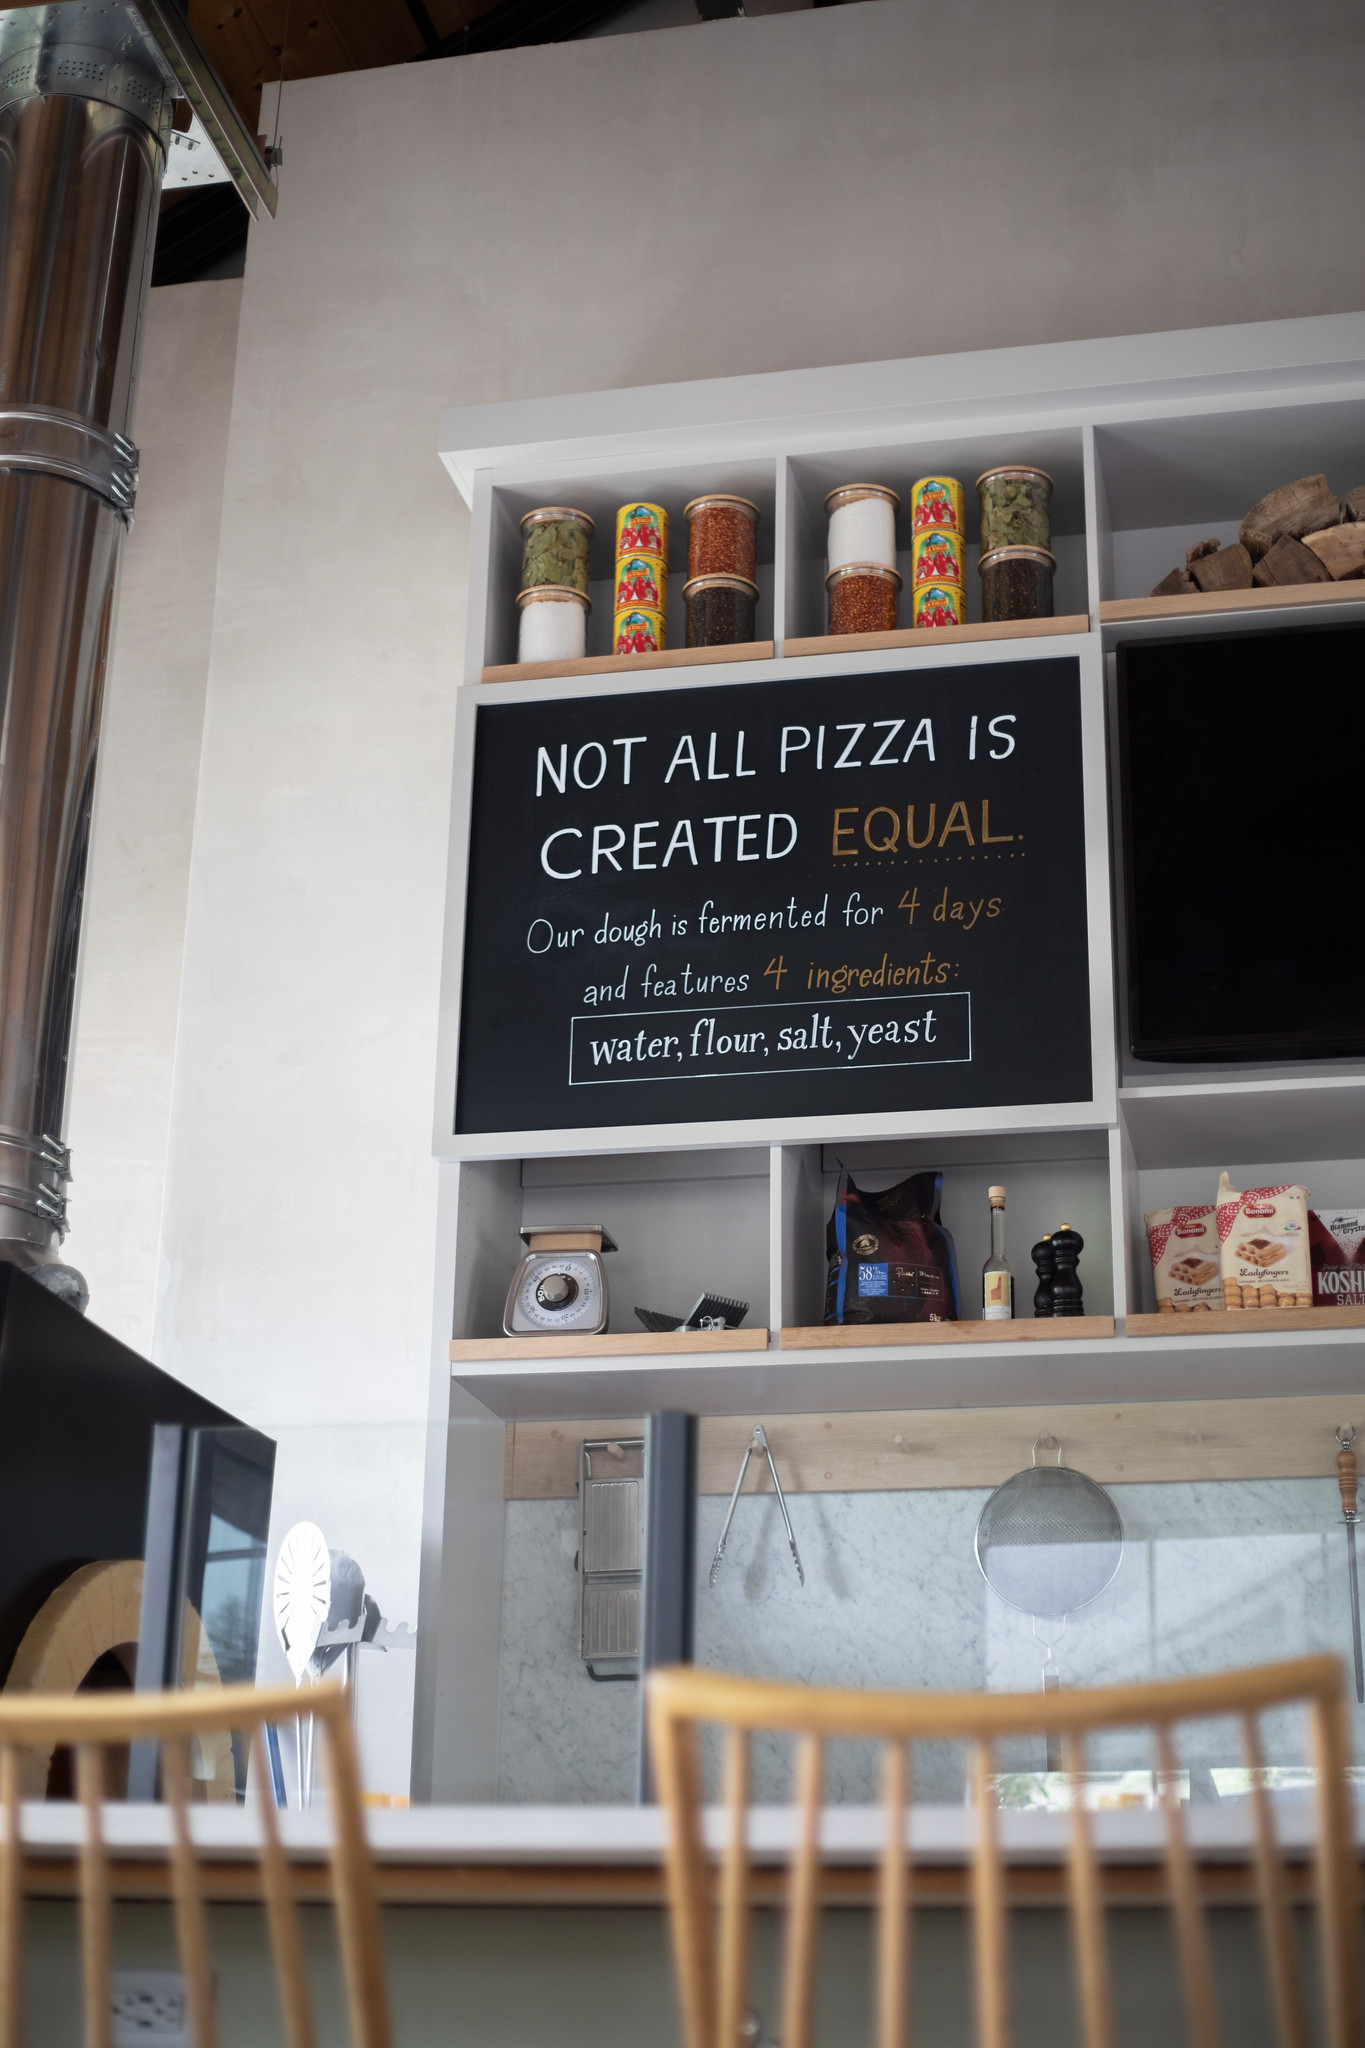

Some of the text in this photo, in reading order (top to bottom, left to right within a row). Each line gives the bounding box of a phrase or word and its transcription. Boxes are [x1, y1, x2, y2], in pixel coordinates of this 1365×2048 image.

[536, 715, 1016, 797] NOT ALL PIZZA IS
[541, 800, 1024, 879] CREATED EQUAL.
[527, 887, 1002, 953] Our dough is fermented for 4 days
[583, 952, 959, 1006] and features 4 ingredients:
[590, 1010, 937, 1066] water, flour, salt, yeast
[1246, 1207, 1273, 1215] Bonomi
[1177, 1226, 1204, 1235] Bonomi
[1330, 1220, 1358, 1231] Diamond
[1343, 1225, 1365, 1235] Crysta
[1240, 1268, 1289, 1278] Ladyfingers
[1317, 1270, 1365, 1294] KOSH
[1336, 1293, 1365, 1306] SALT
